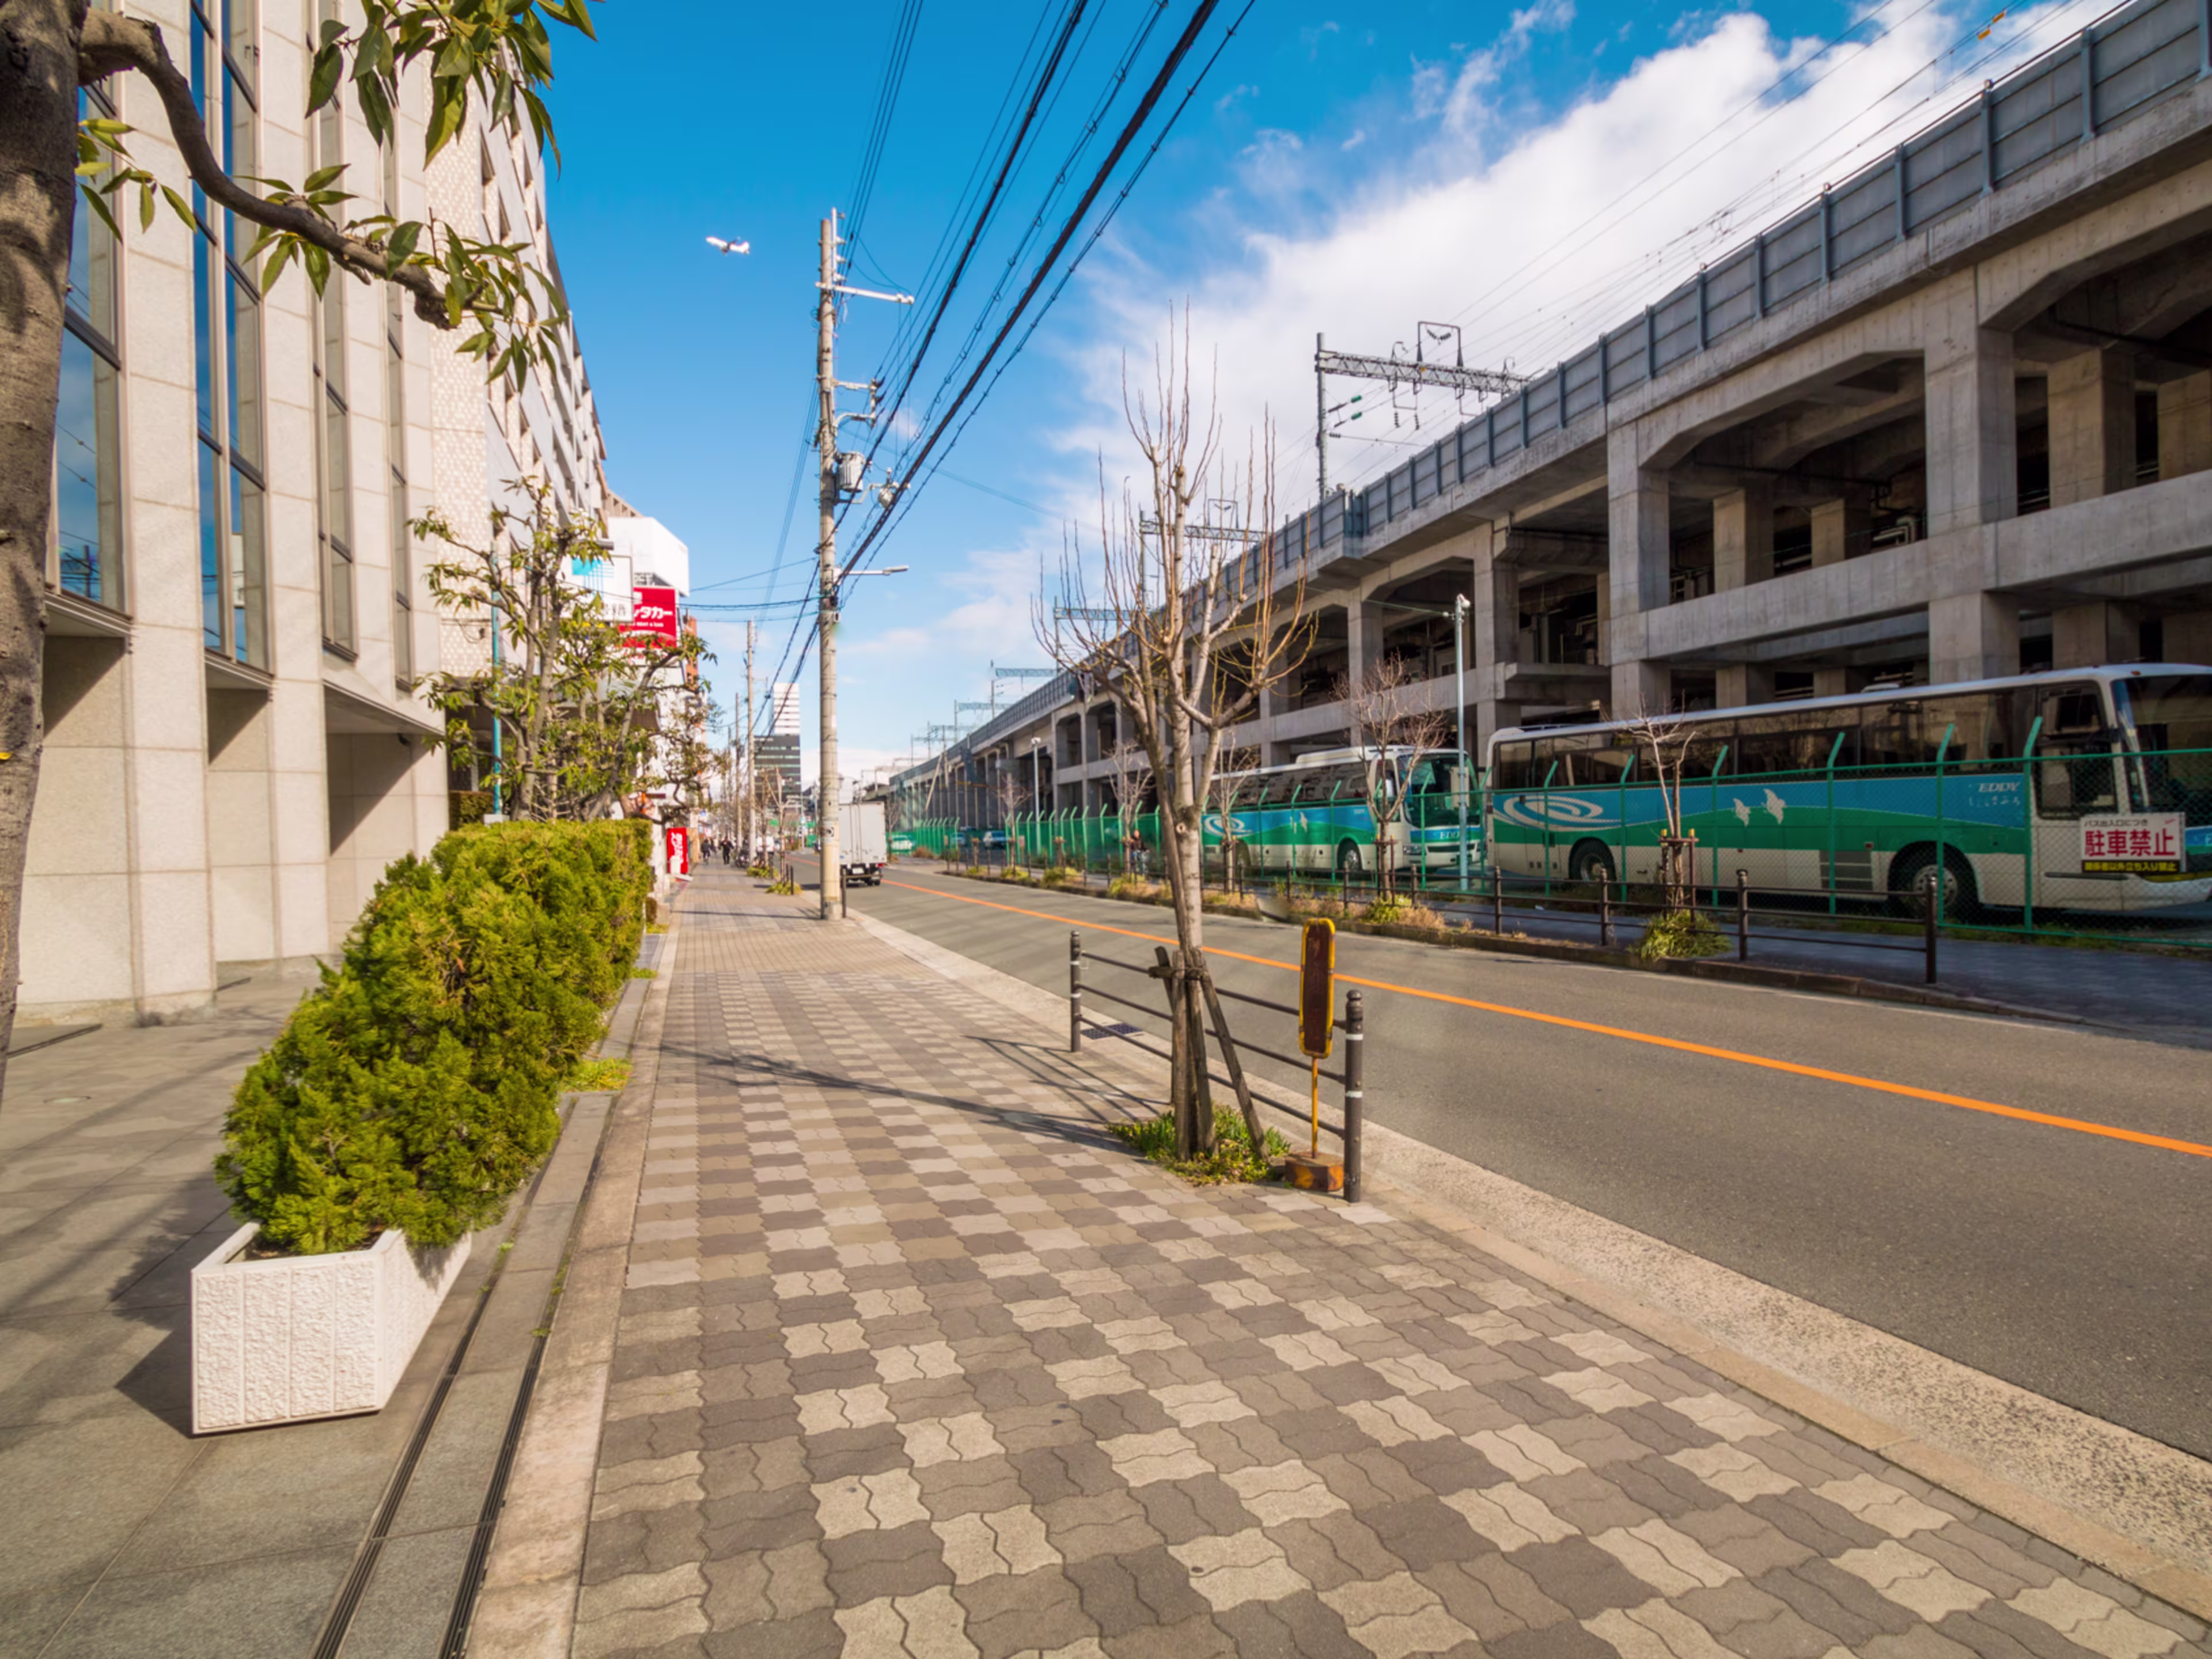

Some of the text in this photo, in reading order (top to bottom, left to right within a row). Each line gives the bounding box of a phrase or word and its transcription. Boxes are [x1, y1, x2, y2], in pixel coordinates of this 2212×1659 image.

[1978, 782, 2021, 793] EDDY
[2084, 819, 2148, 827] バス出入口につき
[2084, 828, 2176, 857] 駐車禁止
